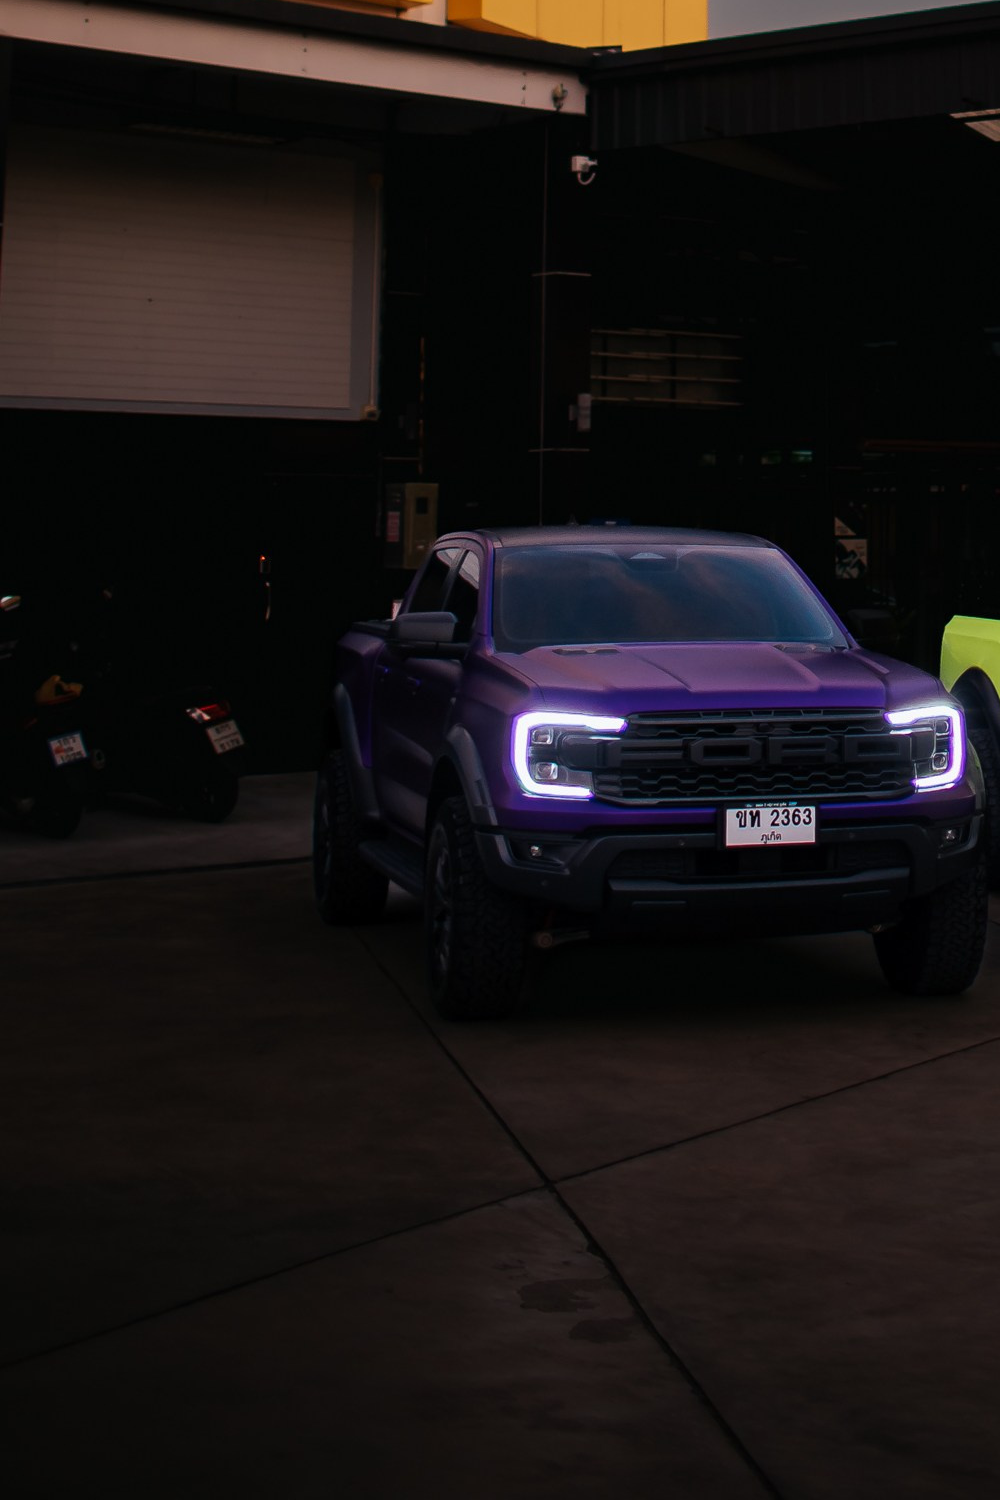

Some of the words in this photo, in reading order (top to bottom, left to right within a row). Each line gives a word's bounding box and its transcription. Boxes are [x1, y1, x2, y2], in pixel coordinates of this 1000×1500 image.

[605, 733, 912, 769] FORD
[770, 807, 813, 828] 2363
[760, 830, 783, 844] ภูเก็ต
